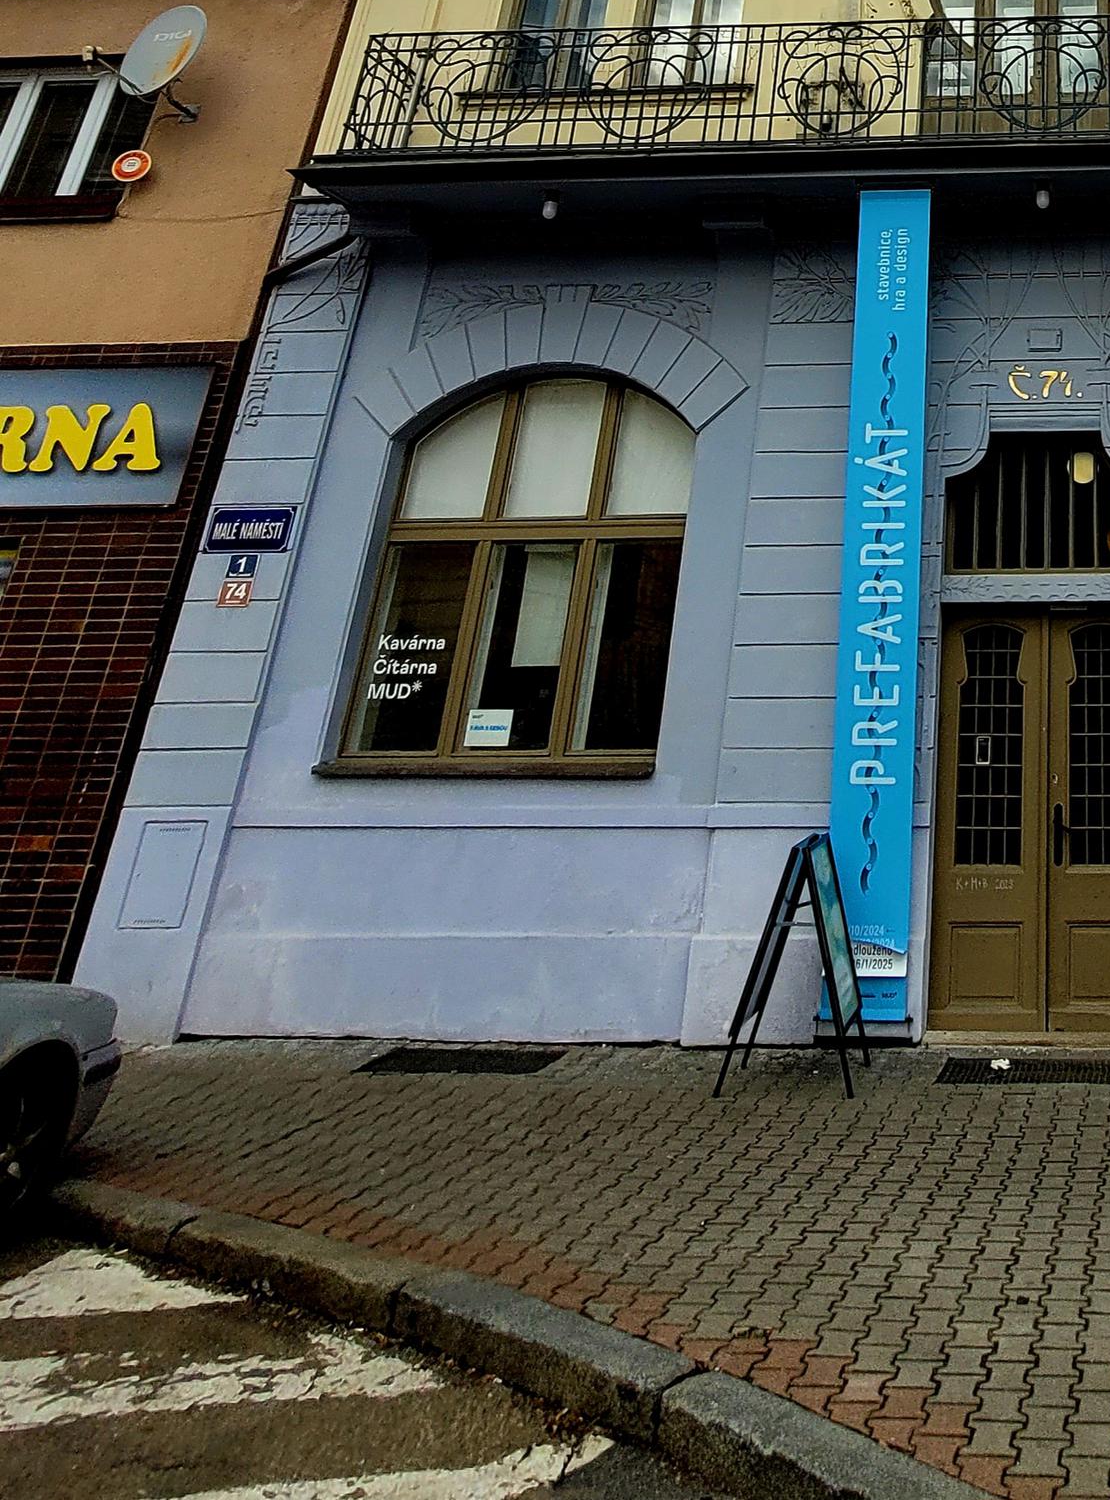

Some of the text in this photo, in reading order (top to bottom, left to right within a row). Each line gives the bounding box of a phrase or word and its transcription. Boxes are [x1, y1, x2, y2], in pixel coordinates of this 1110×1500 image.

[893, 228, 910, 271] design
[876, 229, 893, 301] stavebnice,
[892, 290, 906, 311] hra
[0, 403, 161, 473] RNA
[212, 518, 286, 540] MALÉ NÁMĚSTÍ
[235, 556, 248, 573] 1
[225, 583, 248, 600] 74
[849, 422, 908, 785] PREFABRIKÁT
[378, 634, 446, 650] Kavárna
[373, 654, 437, 675] Čítárna
